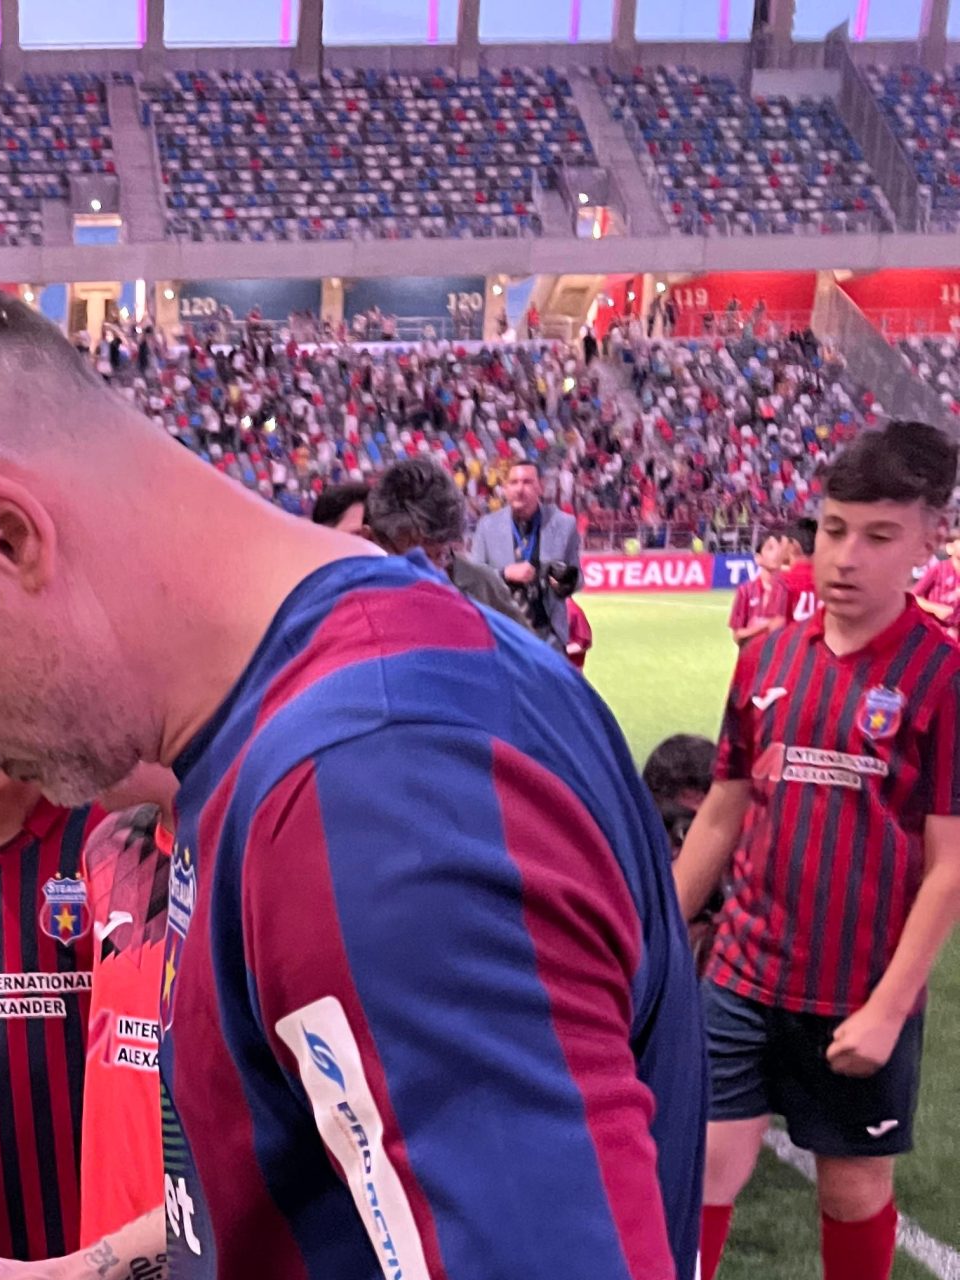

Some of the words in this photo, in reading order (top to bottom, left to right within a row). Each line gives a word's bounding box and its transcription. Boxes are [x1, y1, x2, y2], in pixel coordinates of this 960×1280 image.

[446, 292, 483, 311] 120
[674, 288, 708, 308] 119
[939, 284, 960, 304] 11
[181, 297, 218, 316] 120
[583, 560, 705, 587] STEAUA
